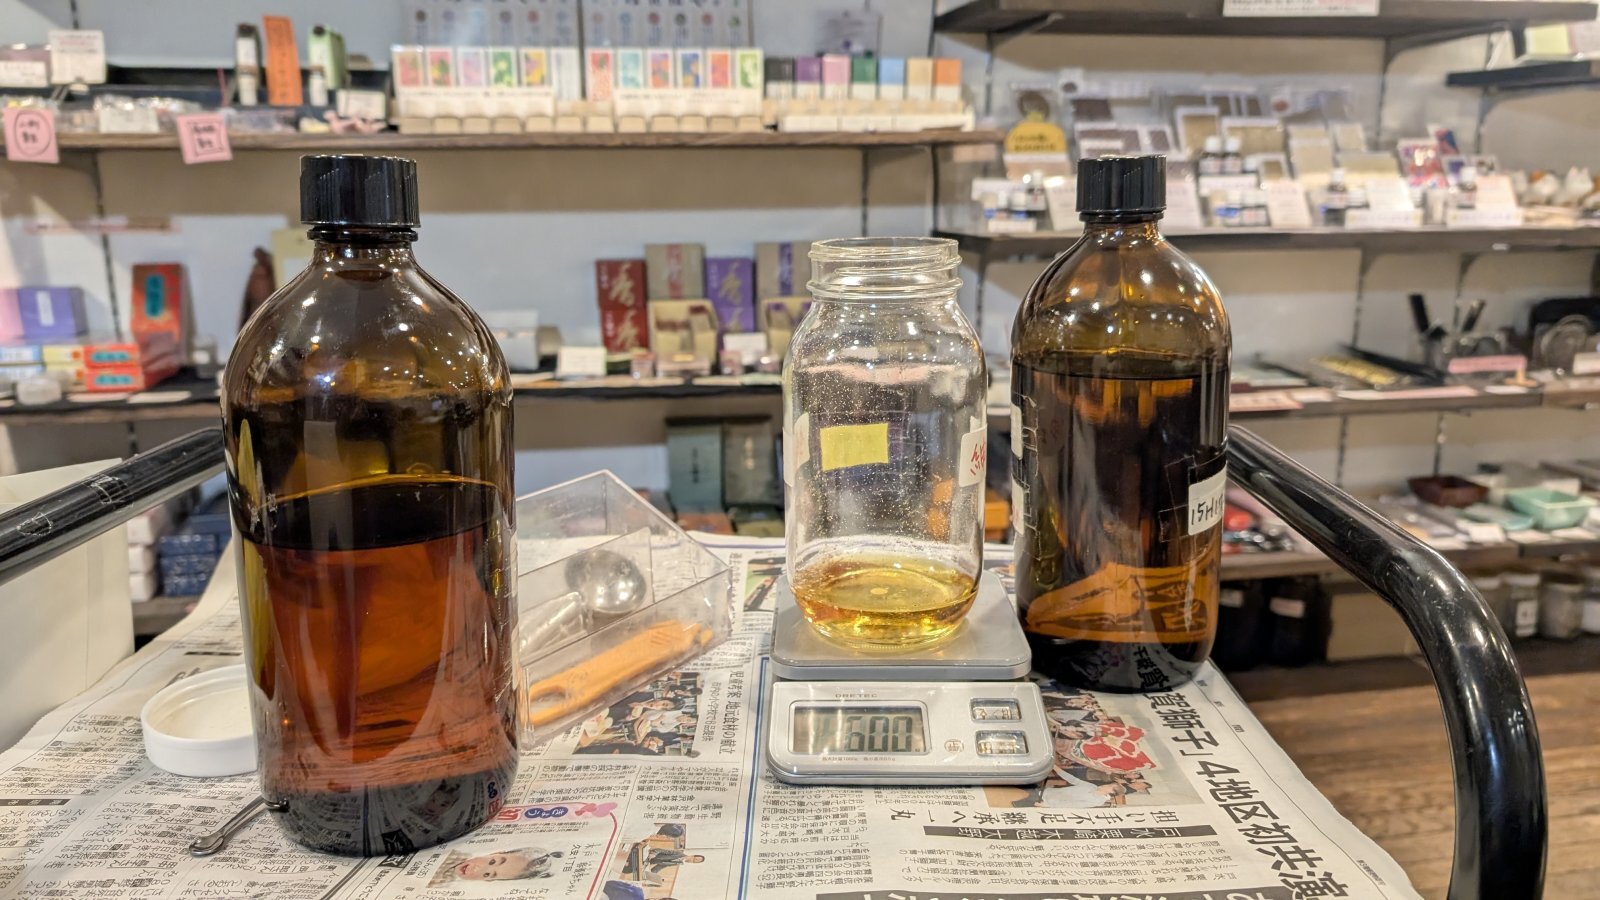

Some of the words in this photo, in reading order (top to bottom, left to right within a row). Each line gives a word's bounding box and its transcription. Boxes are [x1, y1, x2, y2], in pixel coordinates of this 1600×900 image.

[719, 701, 738, 755] 地元食材の献立
